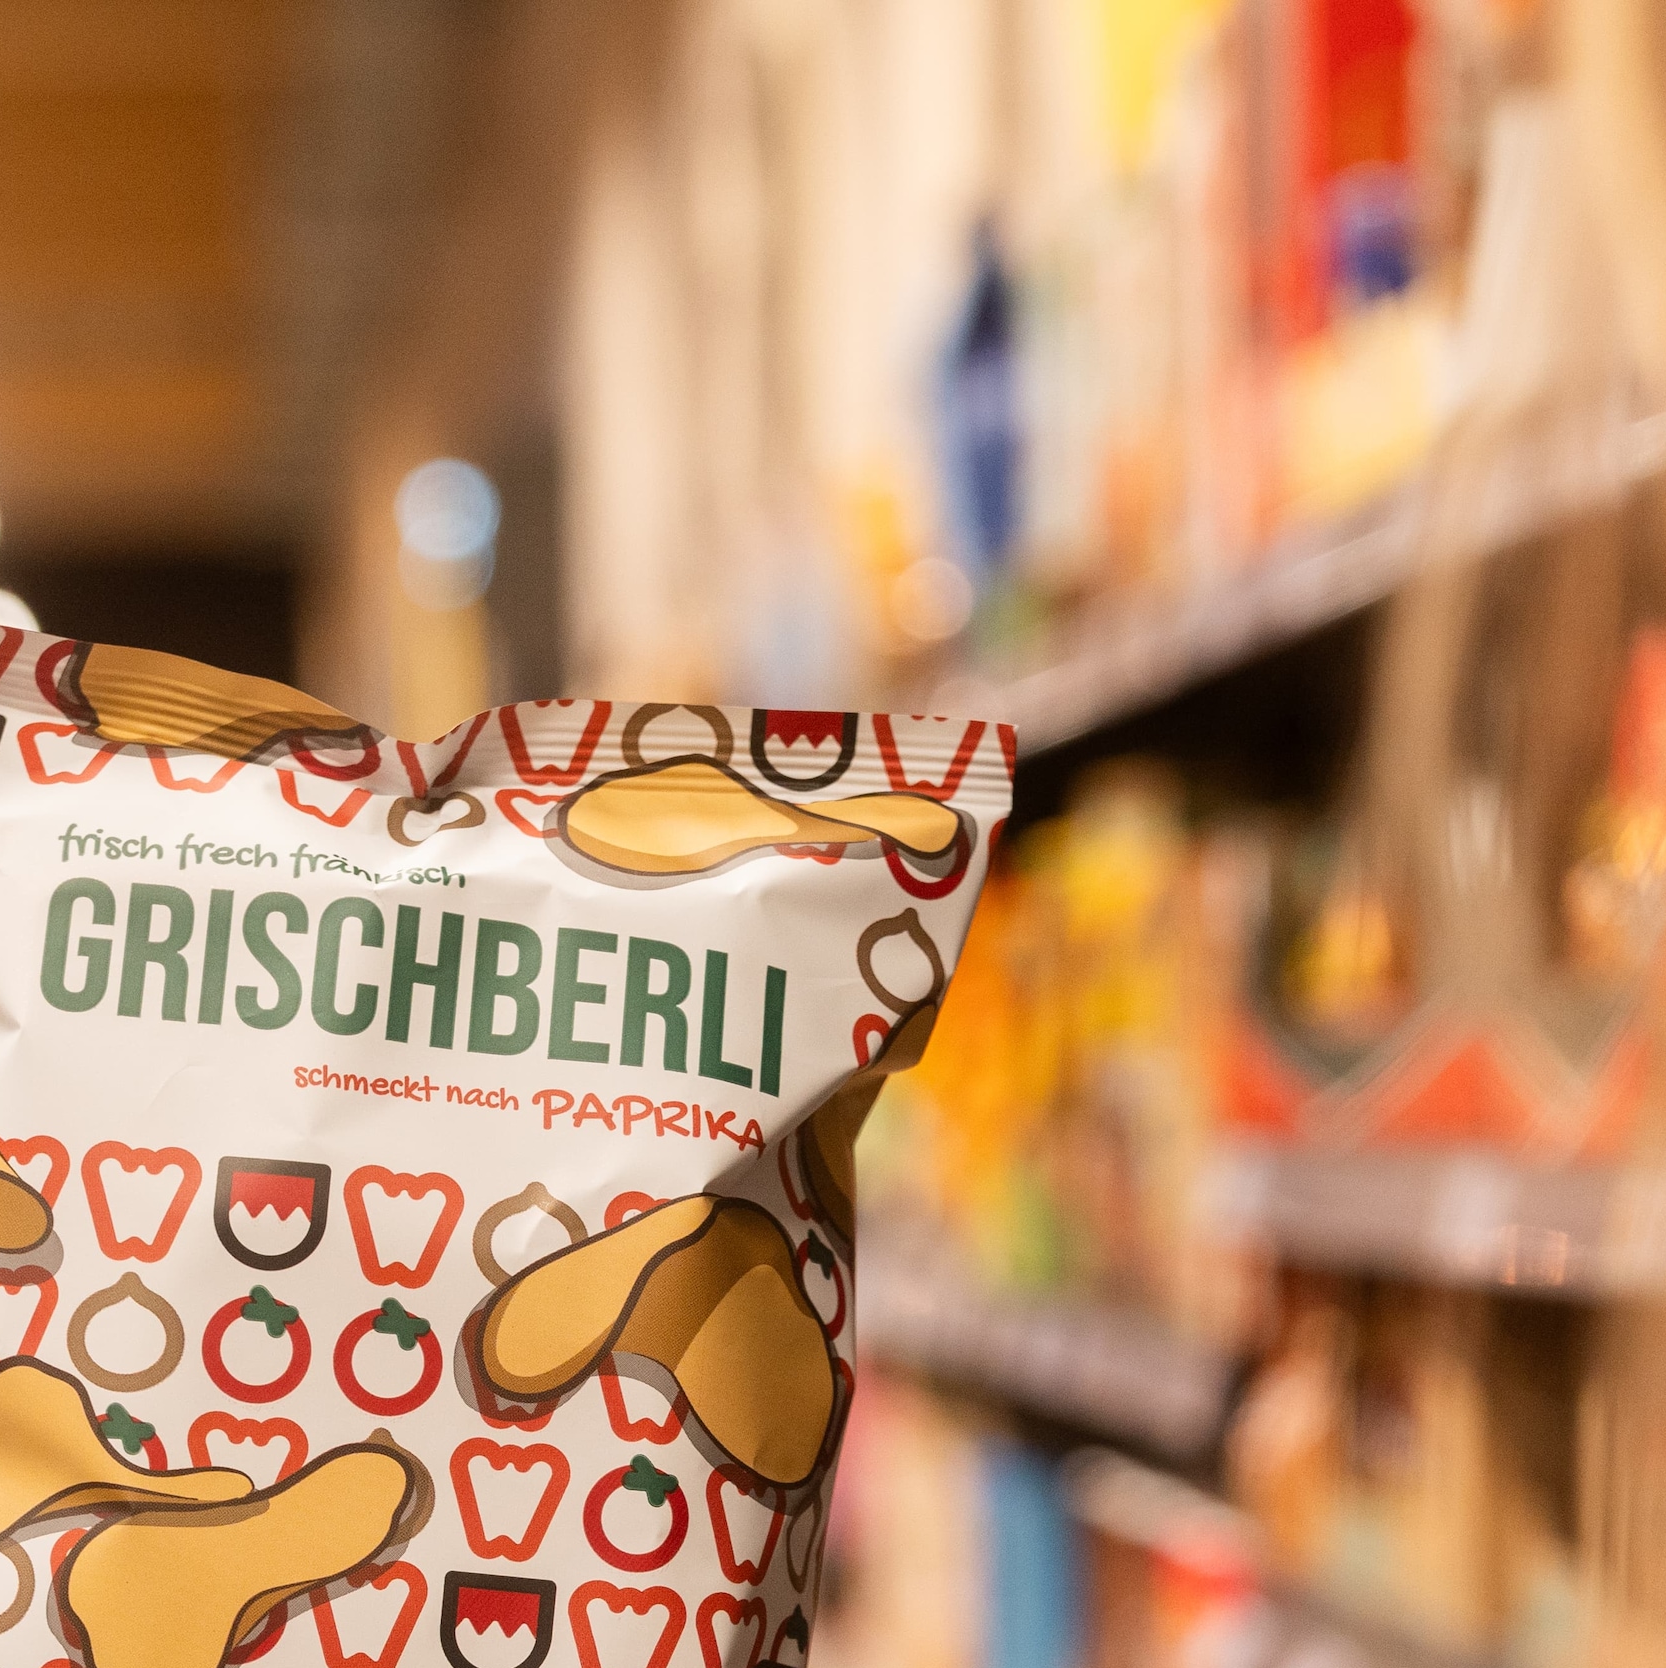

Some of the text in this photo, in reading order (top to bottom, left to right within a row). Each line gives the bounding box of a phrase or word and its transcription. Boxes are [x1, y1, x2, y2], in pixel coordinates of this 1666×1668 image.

[58, 823, 164, 863] frisch
[175, 832, 279, 871] frech
[39, 876, 787, 1098] GRISCHBERLI
[293, 1063, 767, 1160] schmeckt nach PAPRIKA
